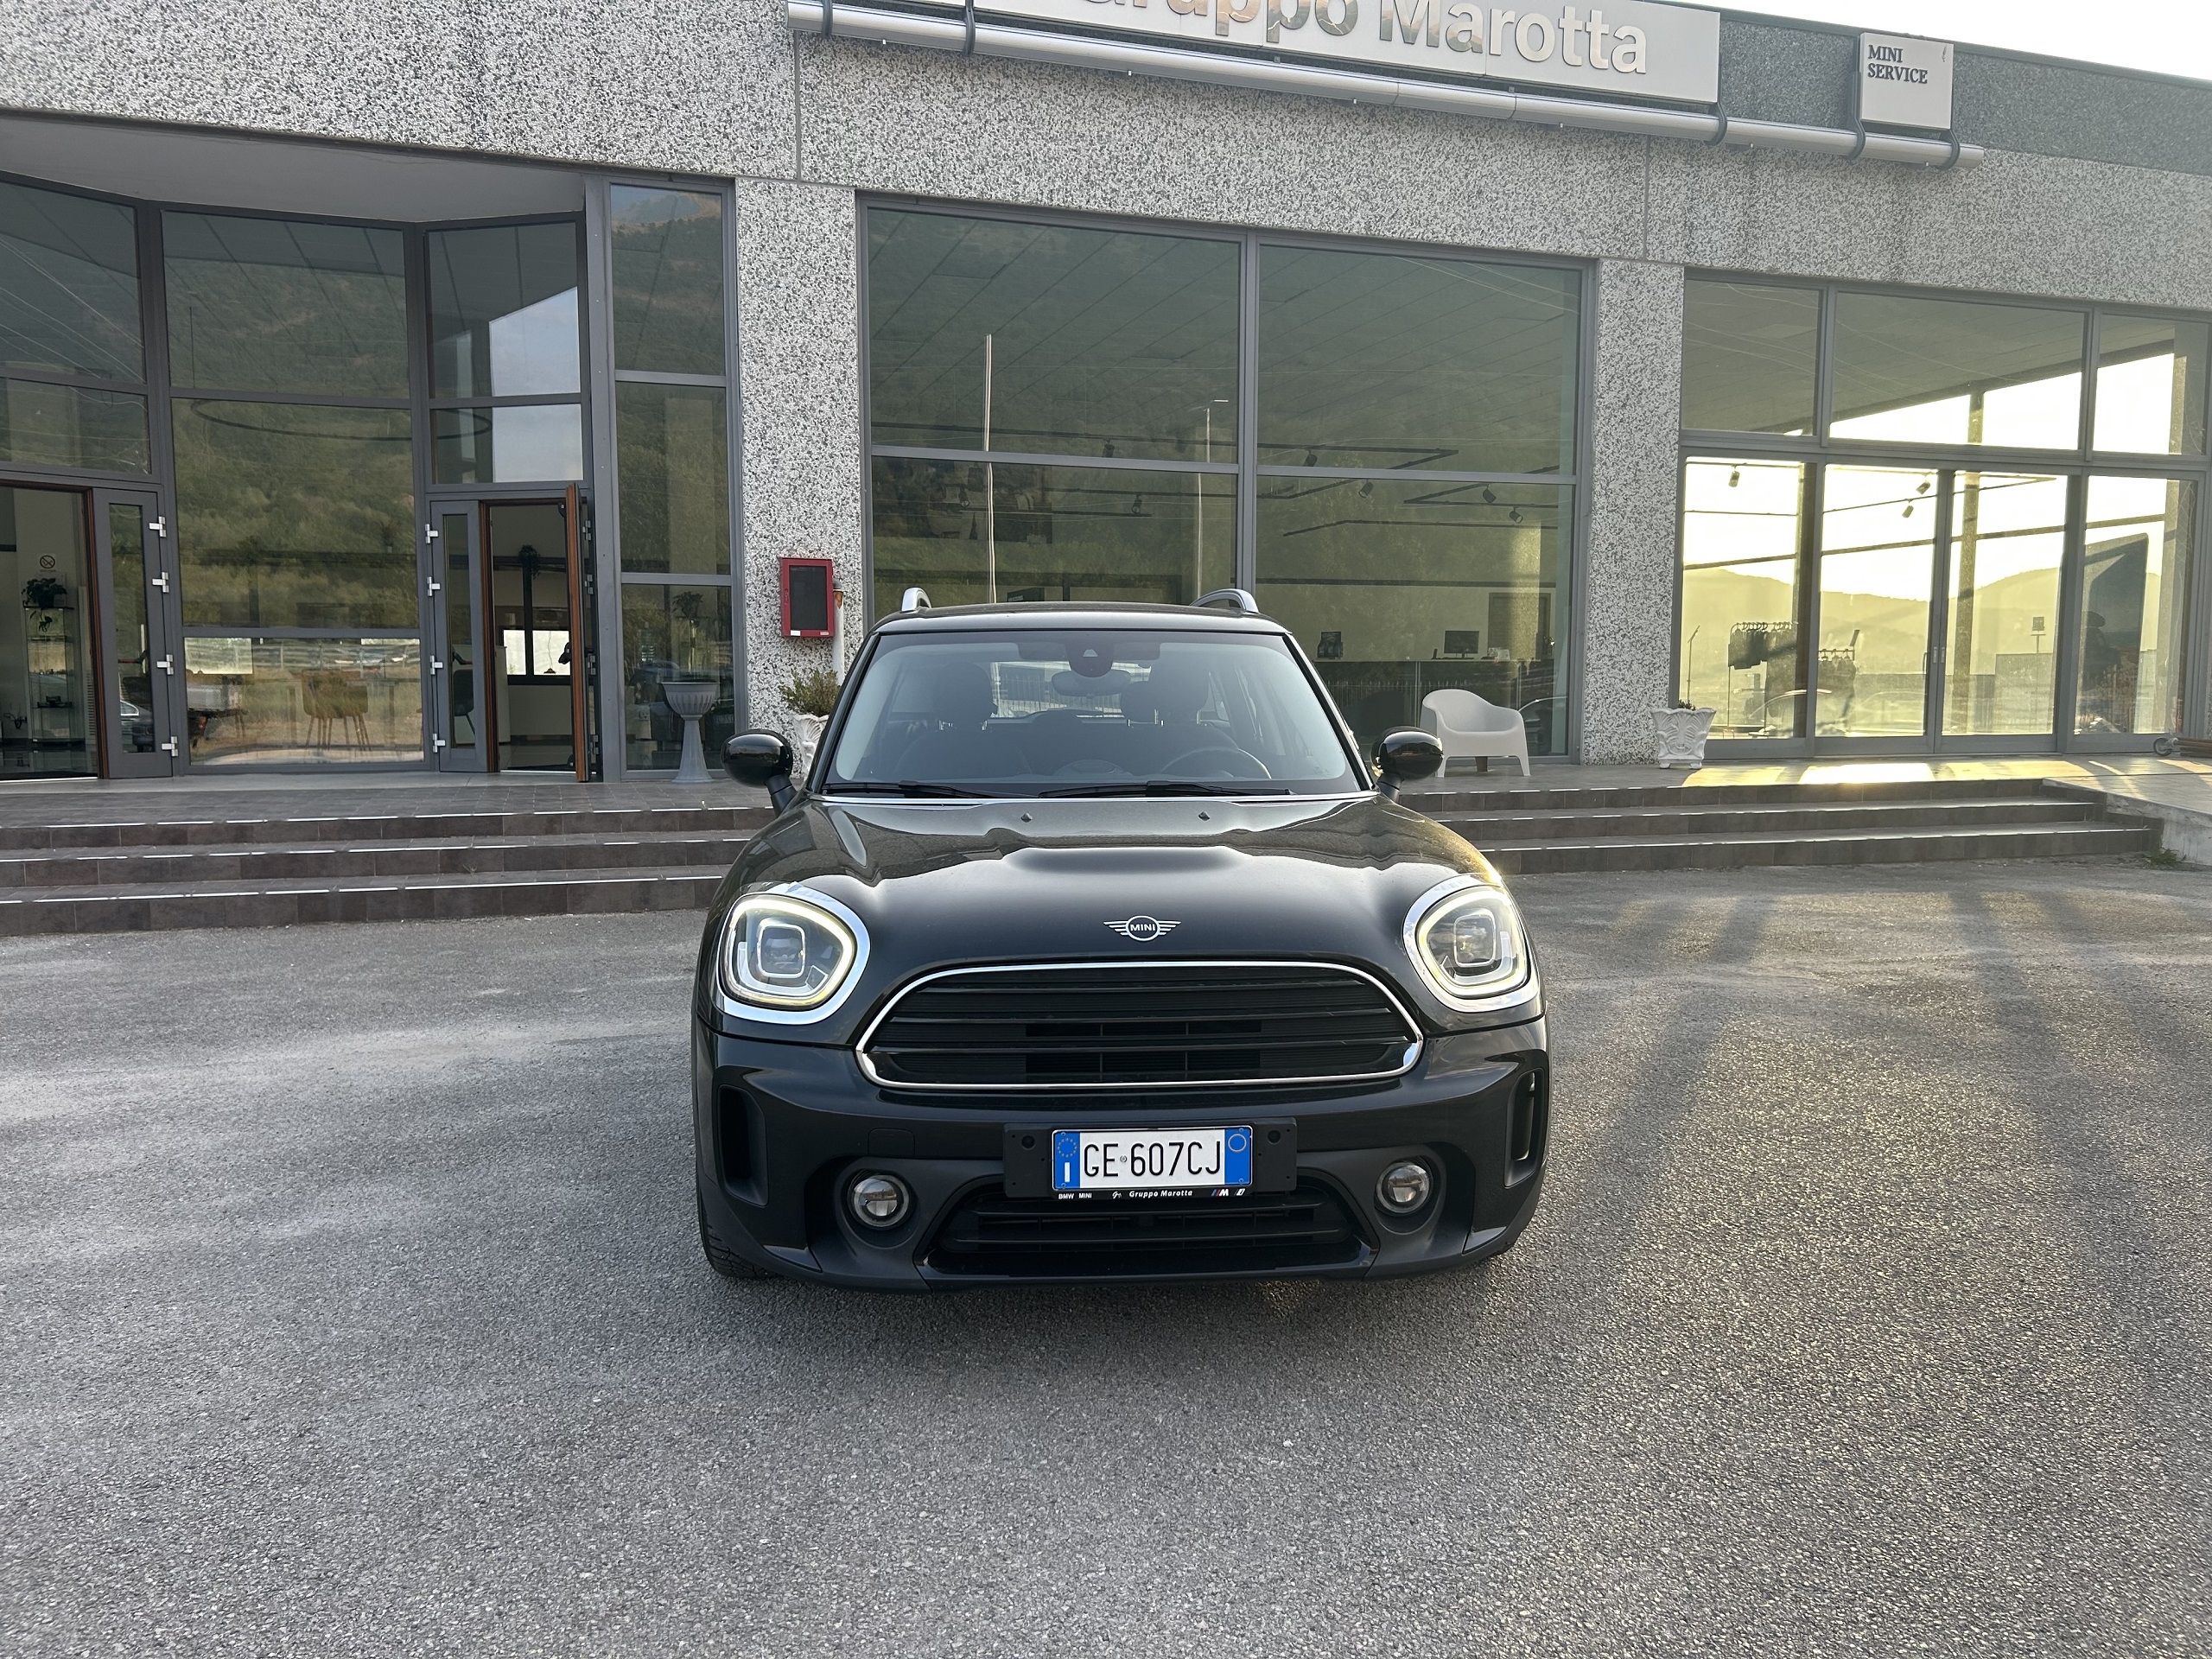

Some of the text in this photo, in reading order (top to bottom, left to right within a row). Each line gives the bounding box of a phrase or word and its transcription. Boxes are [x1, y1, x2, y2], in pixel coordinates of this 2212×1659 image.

[1379, 0, 1647, 74] Marotta
[1868, 44, 1904, 63] MINI
[1867, 62, 1929, 85] SERVICE
[1084, 1143, 1119, 1177] GE
[1130, 1141, 1221, 1177] 607CJ
[1128, 1190, 1159, 1199] Gruppo
[1160, 1189, 1193, 1198] Marotta
